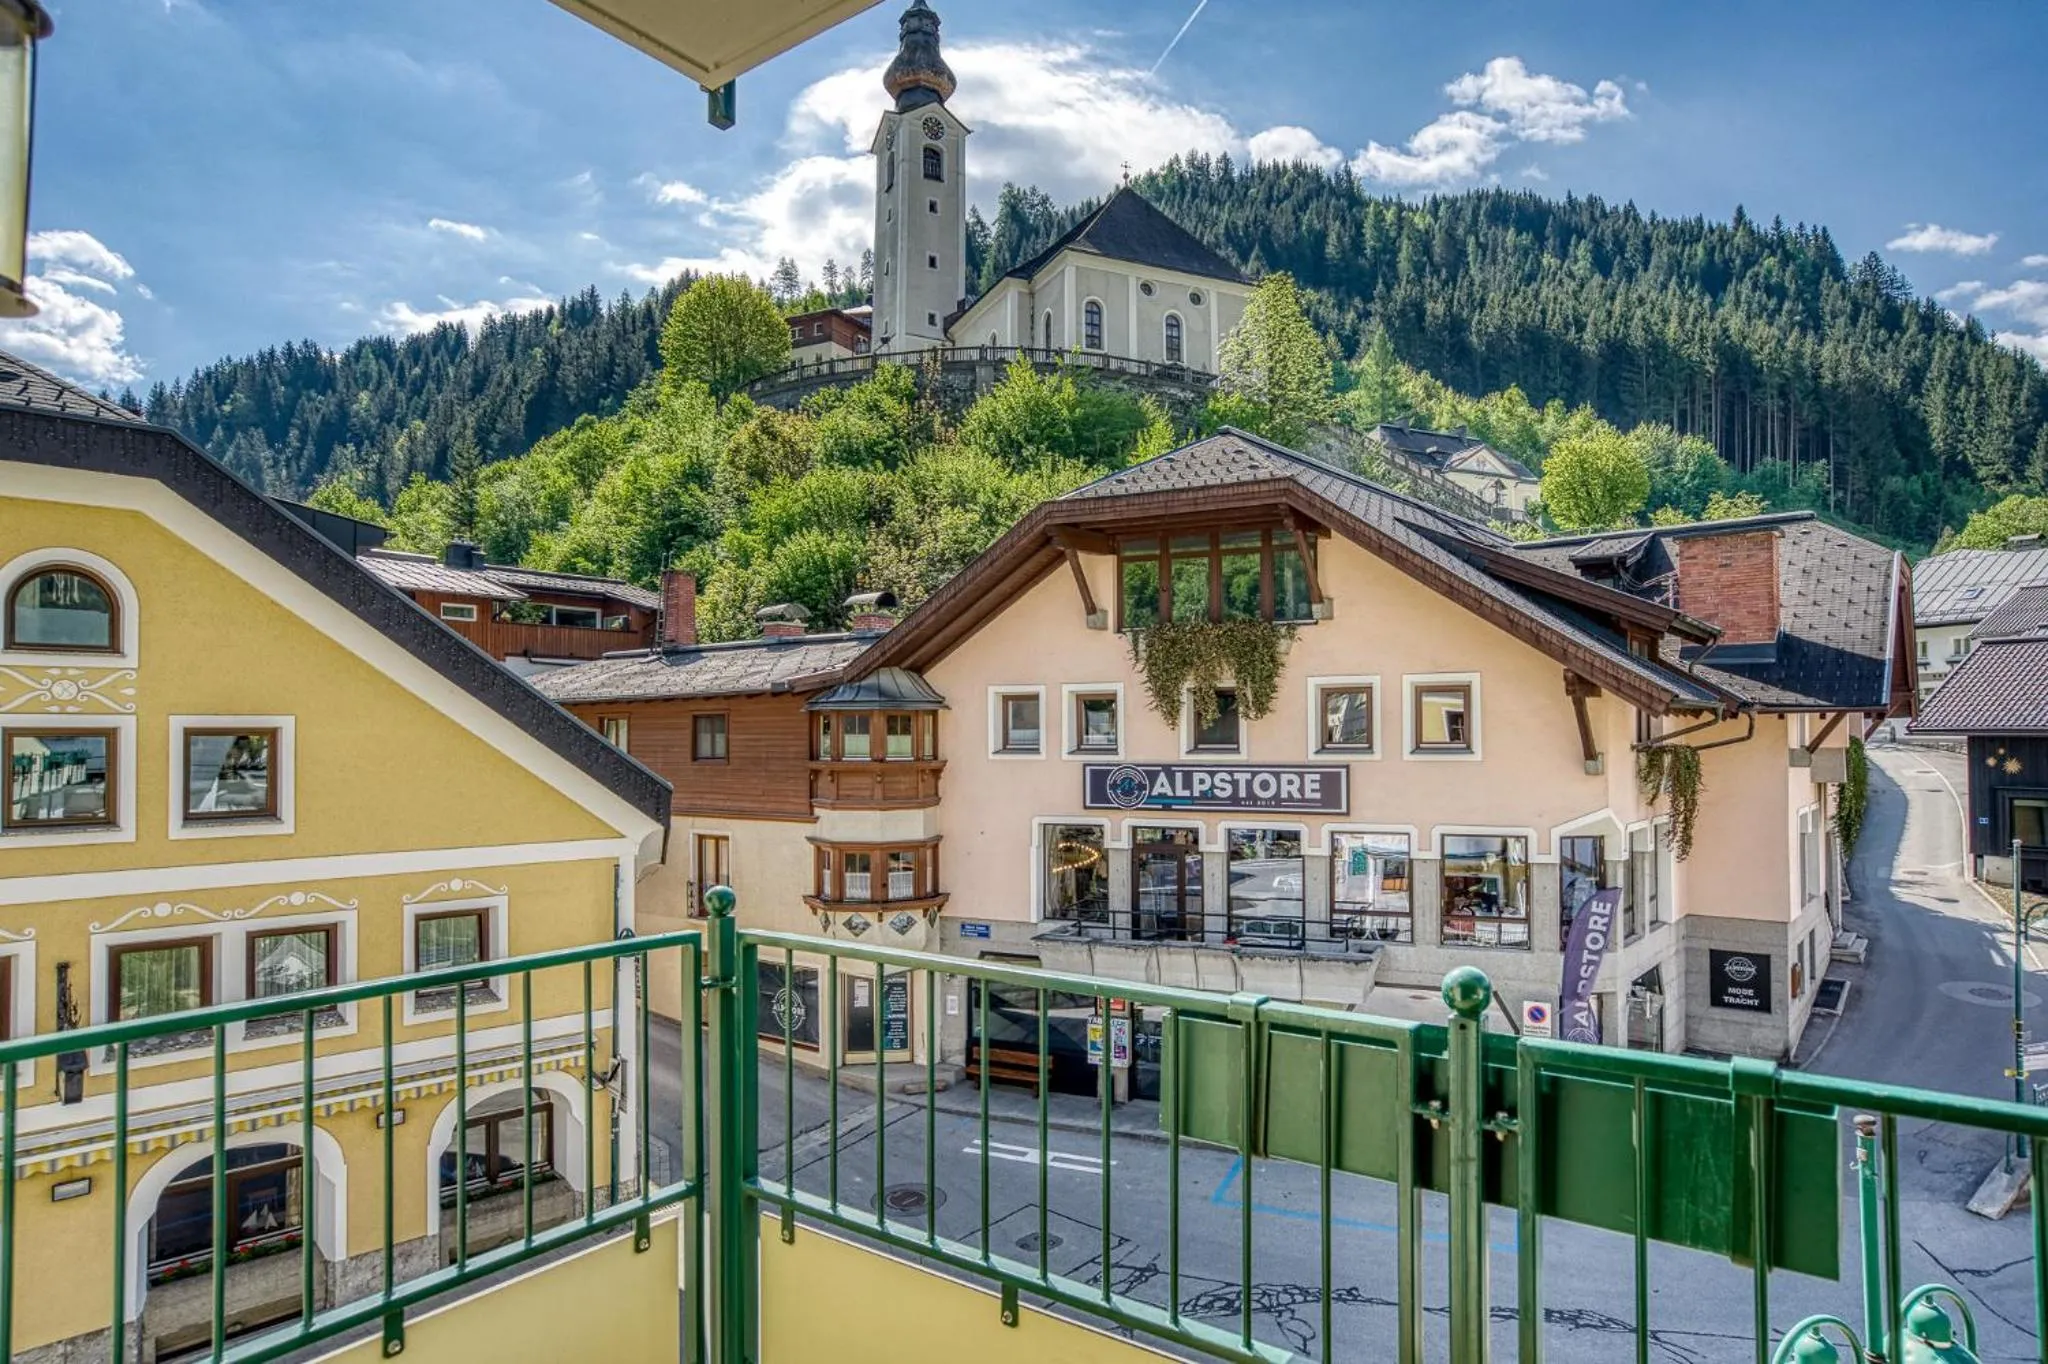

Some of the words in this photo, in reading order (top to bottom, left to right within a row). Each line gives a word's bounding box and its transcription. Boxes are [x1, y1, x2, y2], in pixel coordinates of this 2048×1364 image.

[1151, 771, 1322, 799] ALPSTORE
[1727, 987, 1754, 996] MODE
[1722, 995, 1760, 1006] TRACHT
